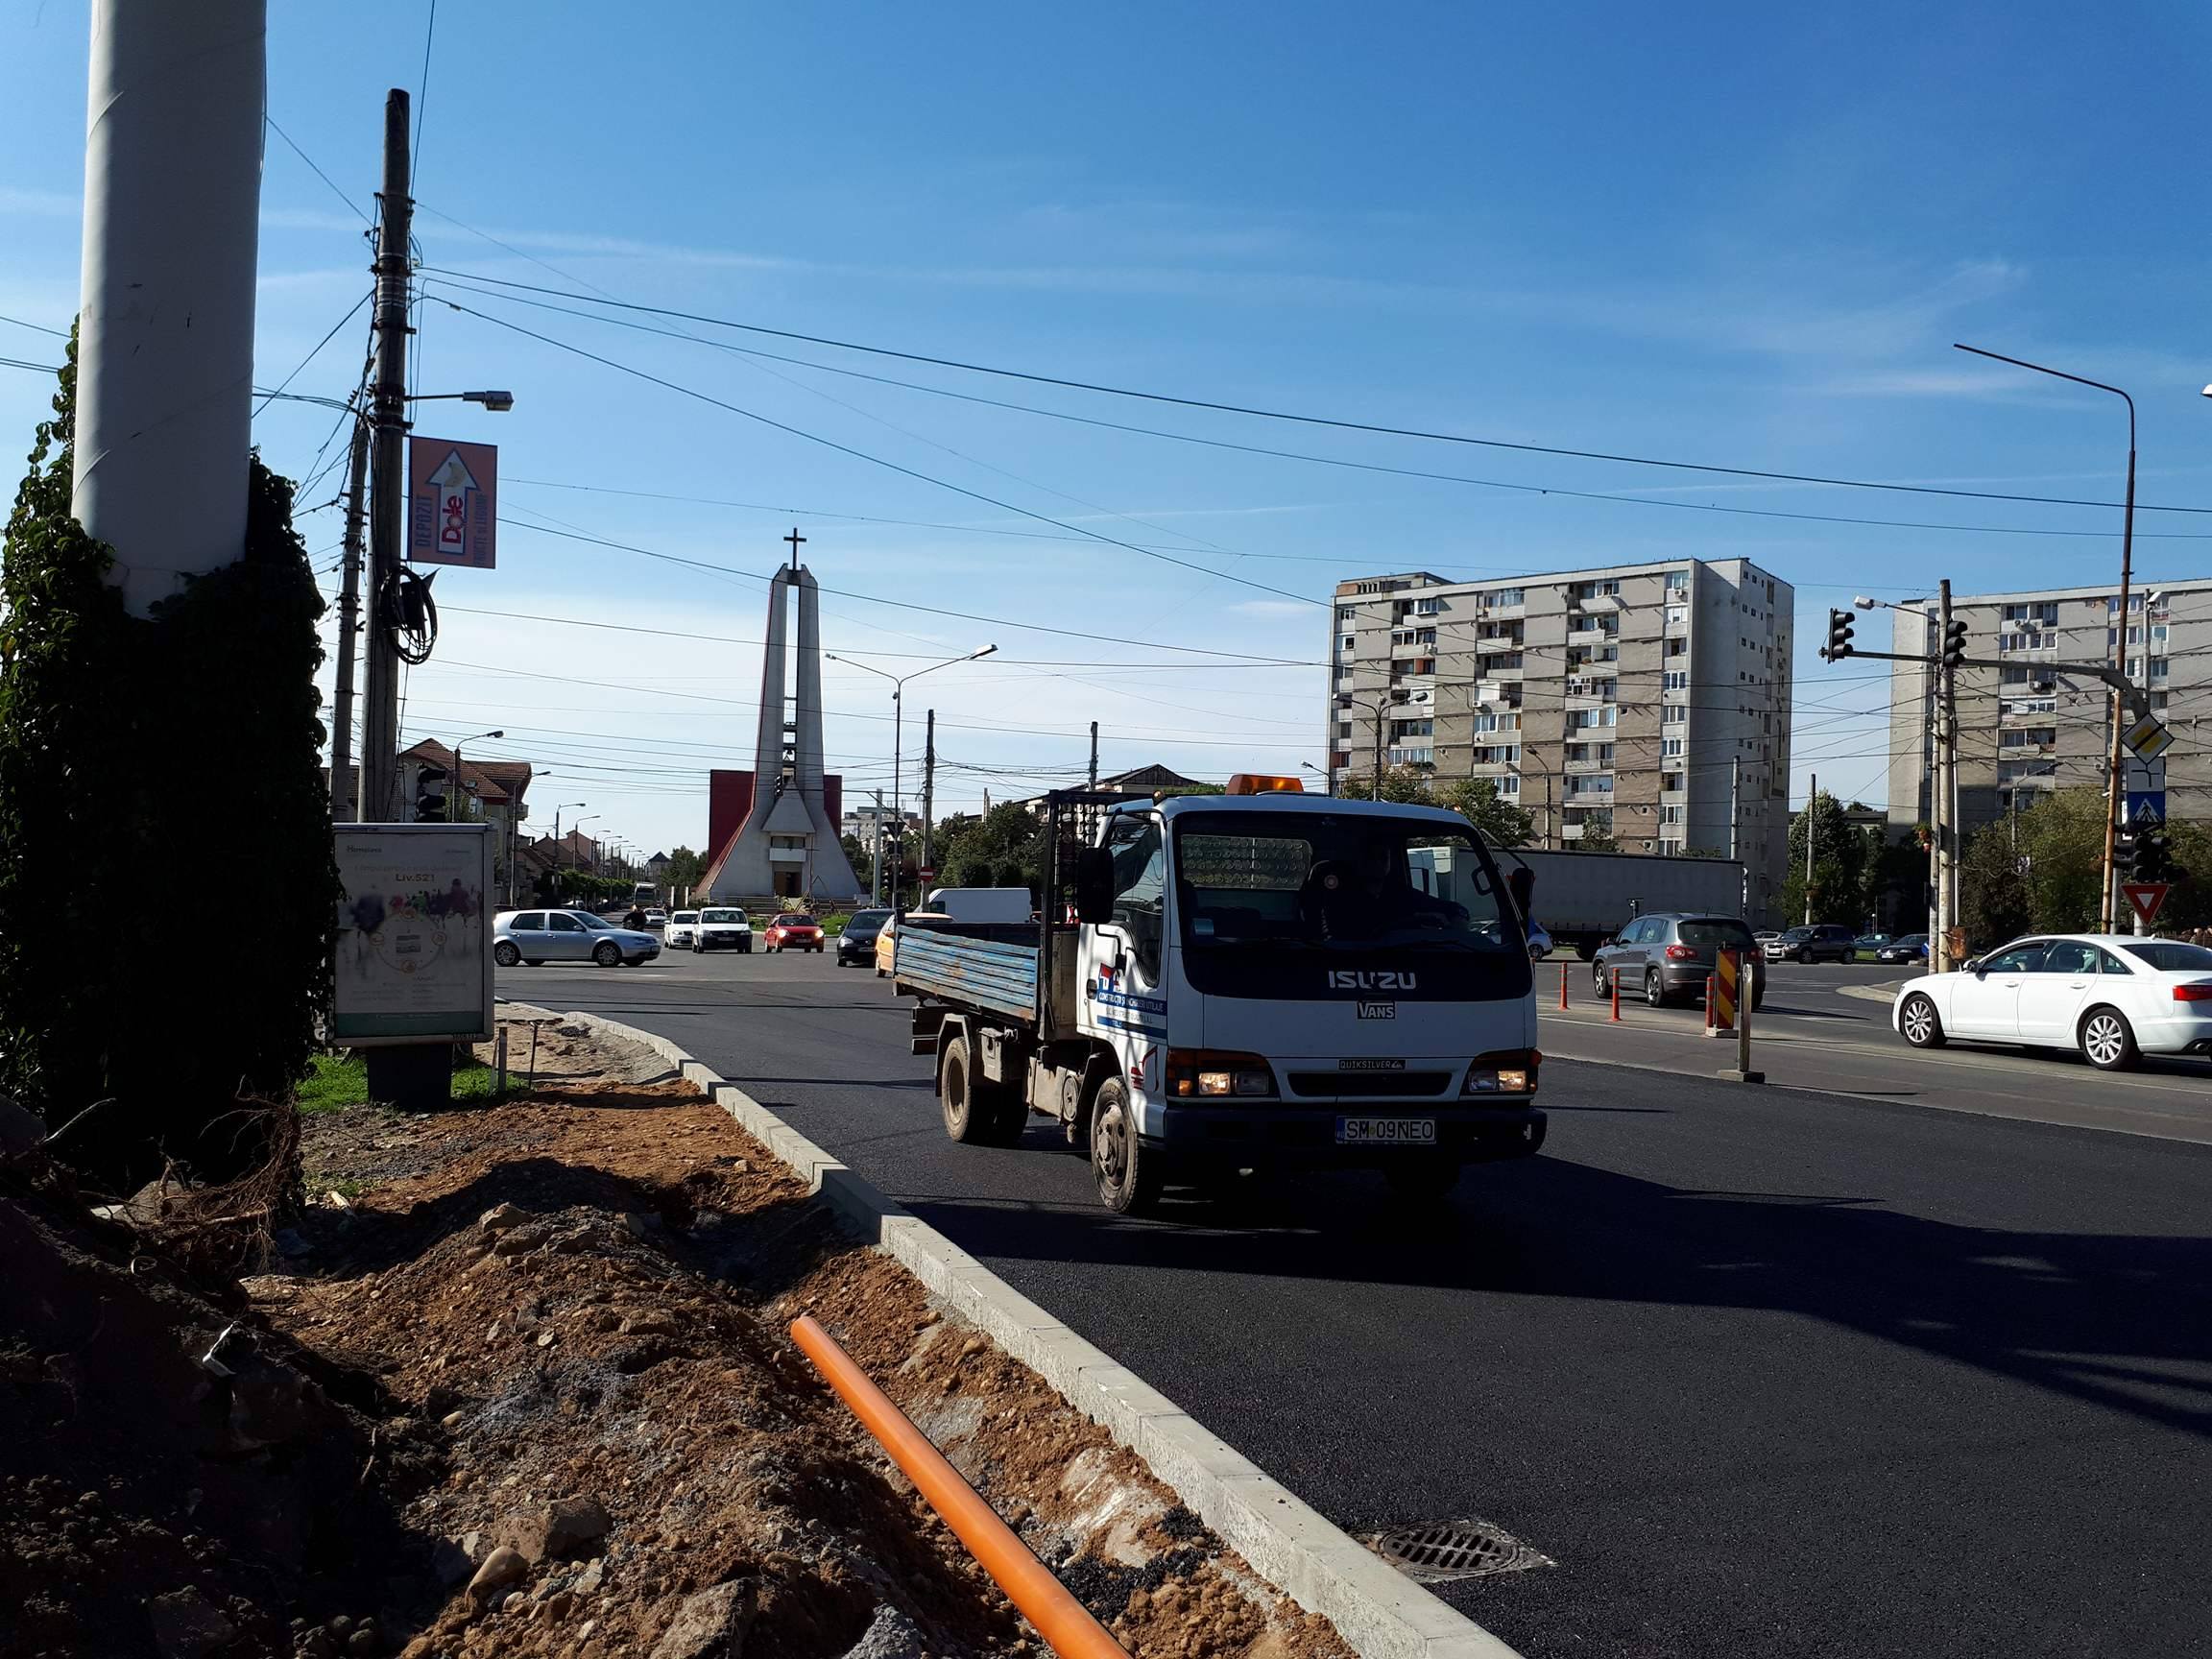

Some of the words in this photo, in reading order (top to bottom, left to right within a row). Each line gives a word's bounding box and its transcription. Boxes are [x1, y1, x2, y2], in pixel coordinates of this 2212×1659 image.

[415, 493, 432, 547] DEPOZIT
[442, 495, 464, 544] Dole
[1328, 971, 1417, 990] ISUZU
[1358, 1002, 1394, 1018] VANS
[1339, 1060, 1391, 1069] QUIKSILVER
